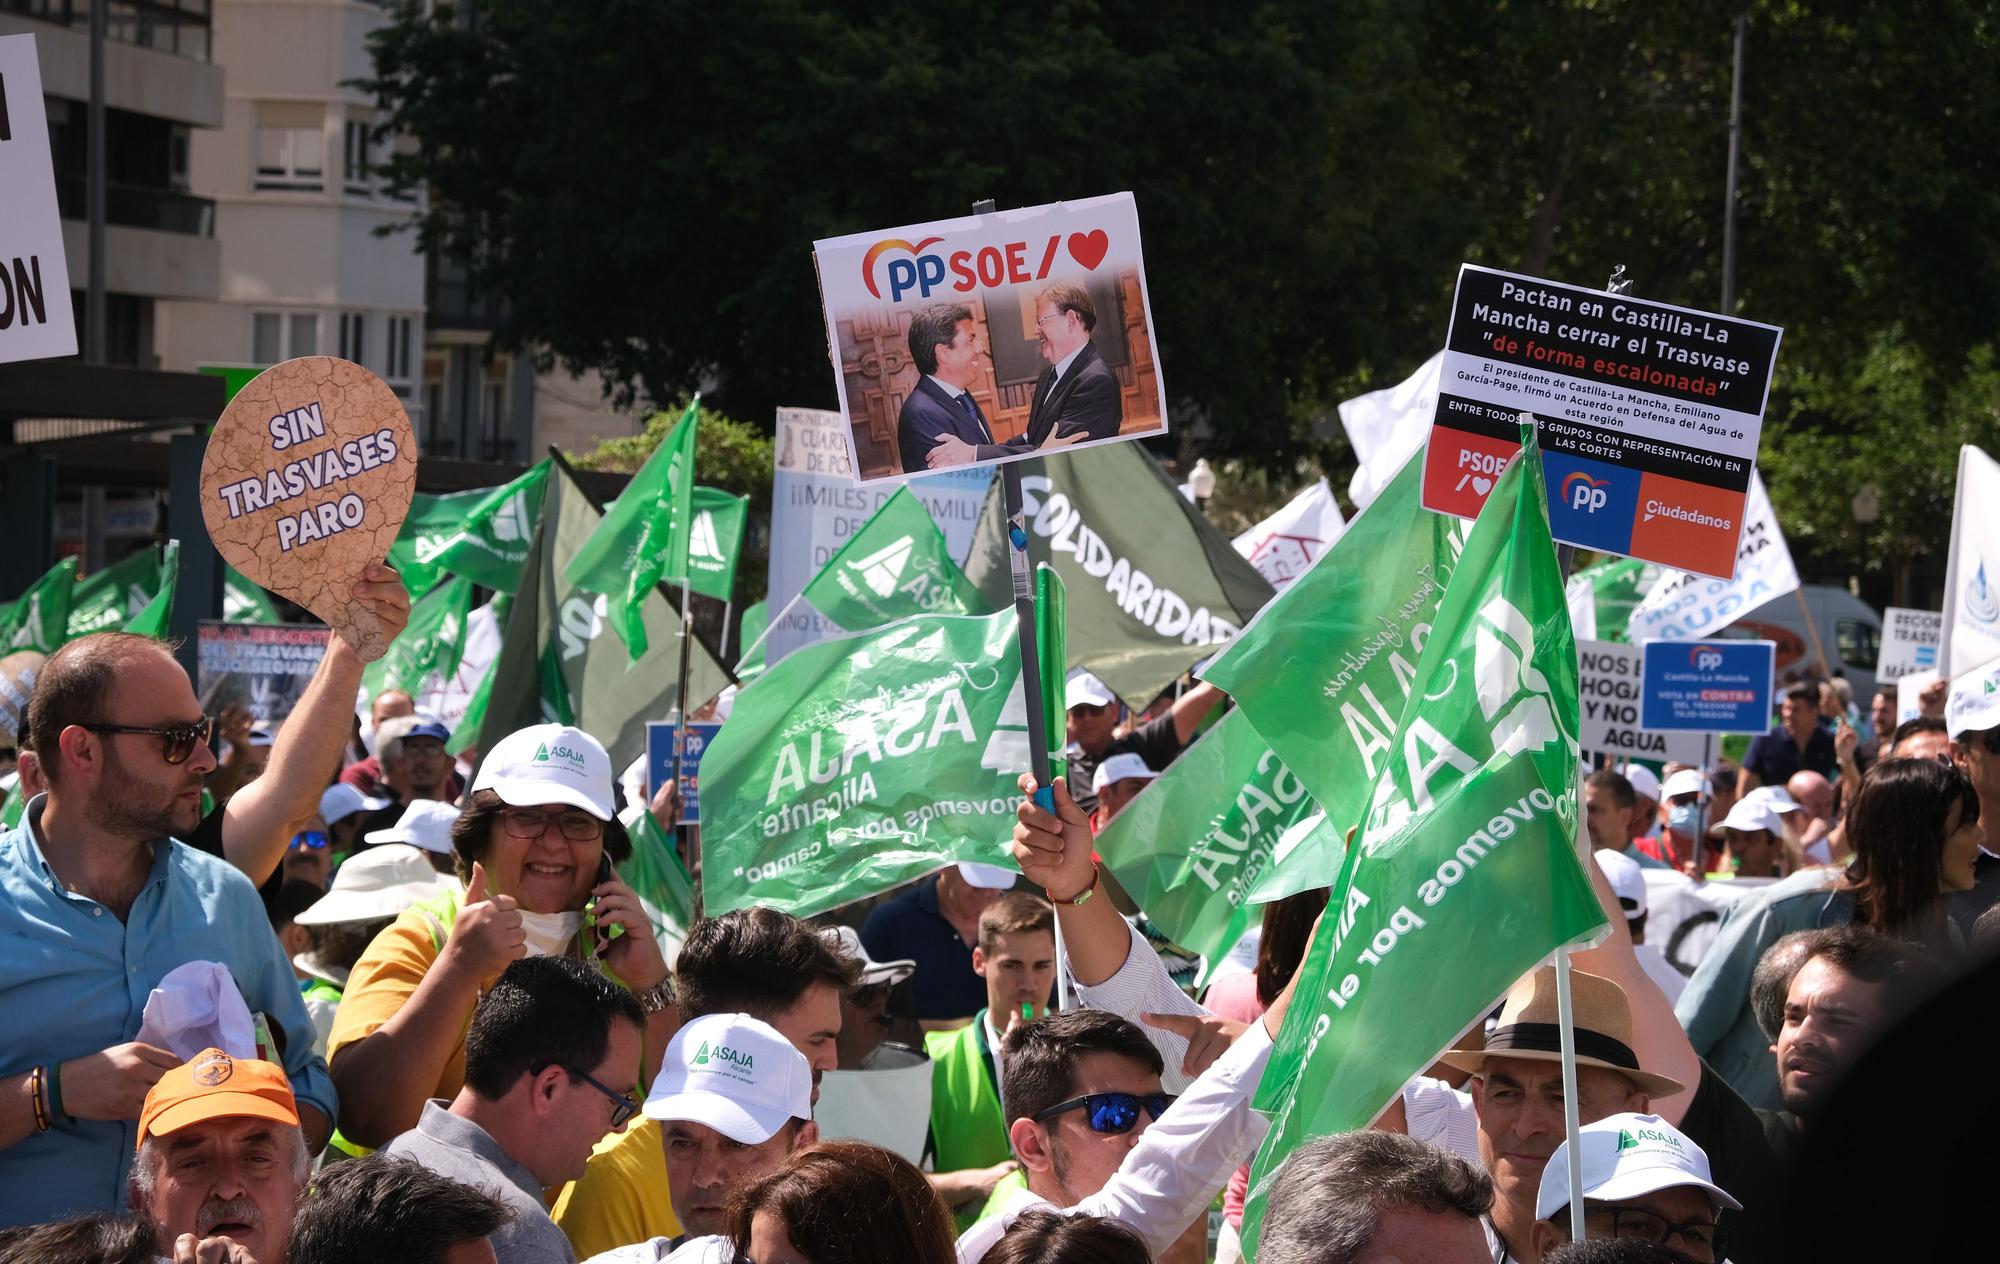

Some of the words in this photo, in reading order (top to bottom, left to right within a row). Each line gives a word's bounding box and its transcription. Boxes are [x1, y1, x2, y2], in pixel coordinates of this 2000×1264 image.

[1501, 280, 1573, 313] Pactan
[1579, 301, 1604, 319] en
[1611, 304, 1730, 344] Castilla-La
[1472, 302, 1550, 335] Mancha
[1557, 323, 1622, 349] cerrar
[1627, 336, 1649, 355] el
[1656, 340, 1751, 376] Trasvase
[1483, 331, 1518, 355] "de
[1525, 340, 1586, 370] forma
[1593, 358, 1731, 398] escalonada"
[1457, 370, 1521, 393] García-Page,
[1524, 384, 1551, 399] firmó
[1554, 392, 1567, 402] un
[1569, 395, 1614, 412] Acuerdo
[1616, 405, 1631, 416] en
[1633, 408, 1676, 426] Defensa
[1679, 417, 1696, 430] del
[1698, 423, 1728, 439] Agua
[1730, 428, 1744, 440] de
[1483, 362, 1494, 374] El
[1496, 365, 1550, 386] presidente
[1553, 378, 1566, 389] de
[1569, 382, 1624, 401] Castilla-La
[1627, 392, 1671, 412] Mancha,
[1674, 404, 1721, 422] Emiliano
[269, 401, 325, 450] SIN
[1565, 408, 1587, 420] esta
[1589, 412, 1625, 429] región
[1448, 399, 1484, 417] ENTRE
[1486, 408, 1522, 425] TODOS
[1548, 422, 1593, 441] GRUPOS
[1595, 432, 1621, 446] CON
[1622, 439, 1722, 470] REPRESENTACIÓN
[1725, 459, 1742, 473] EN
[1555, 437, 1577, 450] LAS
[1579, 443, 1623, 460] CORTES
[219, 428, 398, 519] TRASVASES
[1458, 449, 1508, 477] PSOE
[276, 493, 366, 552] PARO
[1646, 498, 1731, 532] Ciudadanos
[1581, 652, 1629, 676] NOS
[1700, 688, 1755, 703] CONTRA
[1586, 700, 1600, 719] Y
[1603, 702, 1638, 725] NO
[550, 746, 585, 765] ASAJA
[1603, 727, 1668, 754] AGUA
[711, 1046, 753, 1069] ASAJA
[1638, 1129, 1683, 1150] ASAJA
